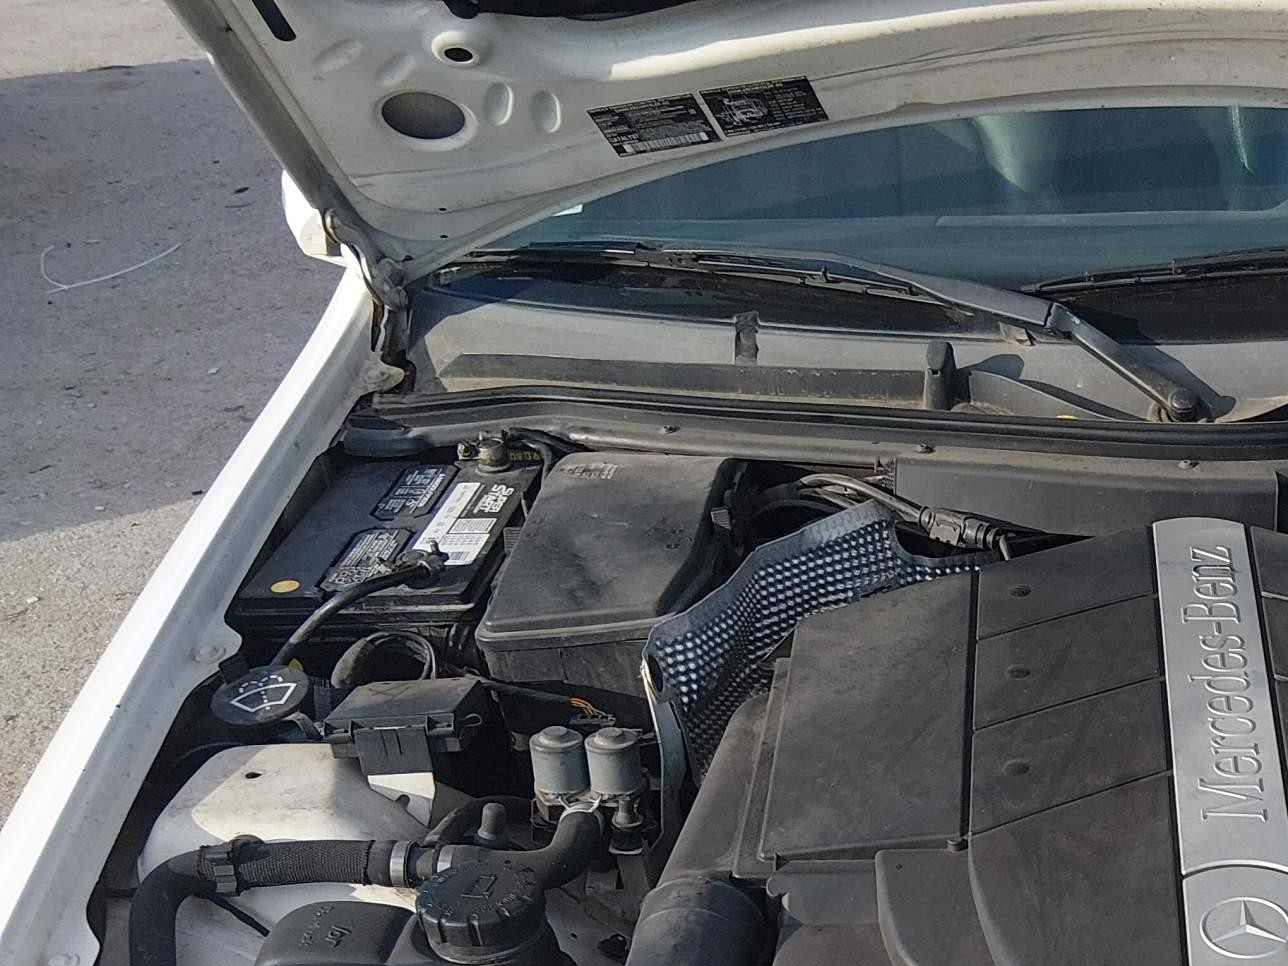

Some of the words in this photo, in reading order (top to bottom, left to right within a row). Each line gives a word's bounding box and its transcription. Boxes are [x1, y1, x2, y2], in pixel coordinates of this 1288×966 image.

[479, 484, 507, 513] START
[489, 487, 515, 513] SUPER
[1181, 546, 1268, 822] Mercedes-Benz
